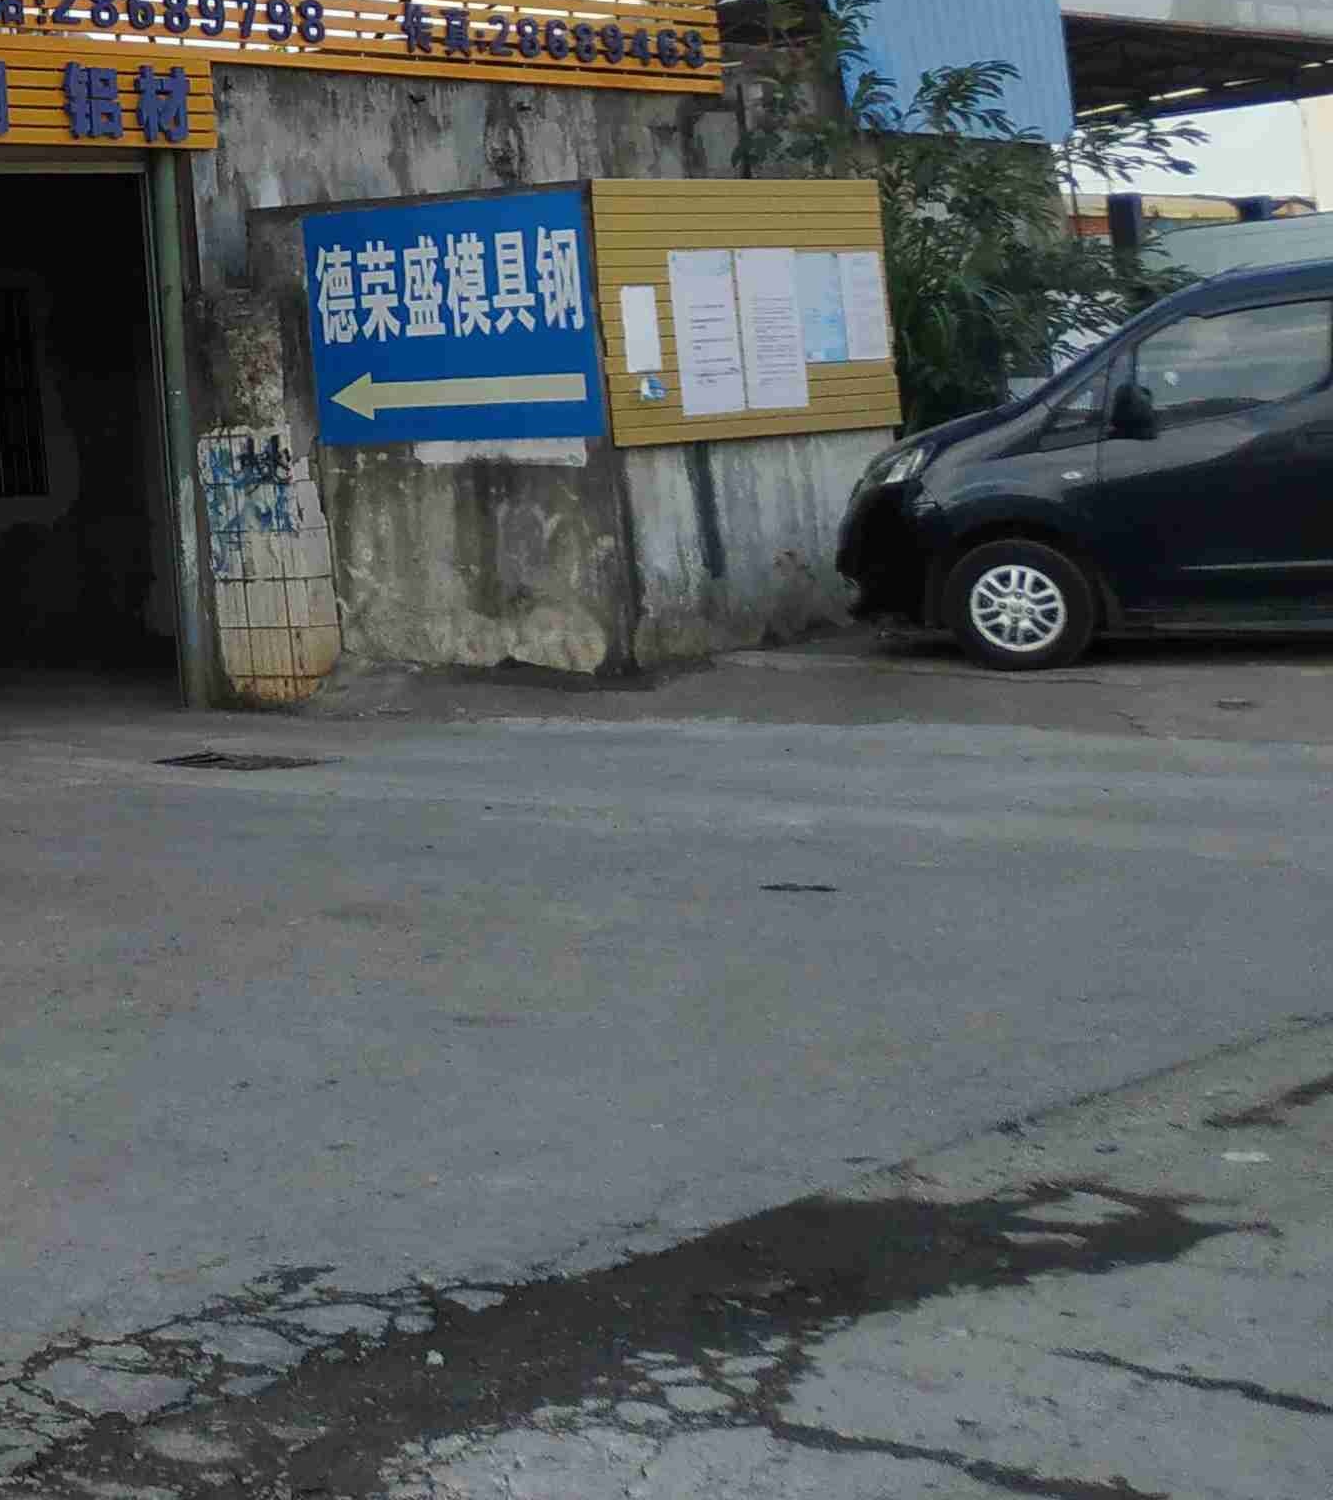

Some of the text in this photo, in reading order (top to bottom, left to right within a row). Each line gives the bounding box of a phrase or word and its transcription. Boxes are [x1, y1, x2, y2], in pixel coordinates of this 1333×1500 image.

[63, 61, 190, 142] 铝材
[316, 225, 585, 346] 德荣盛模具钢
